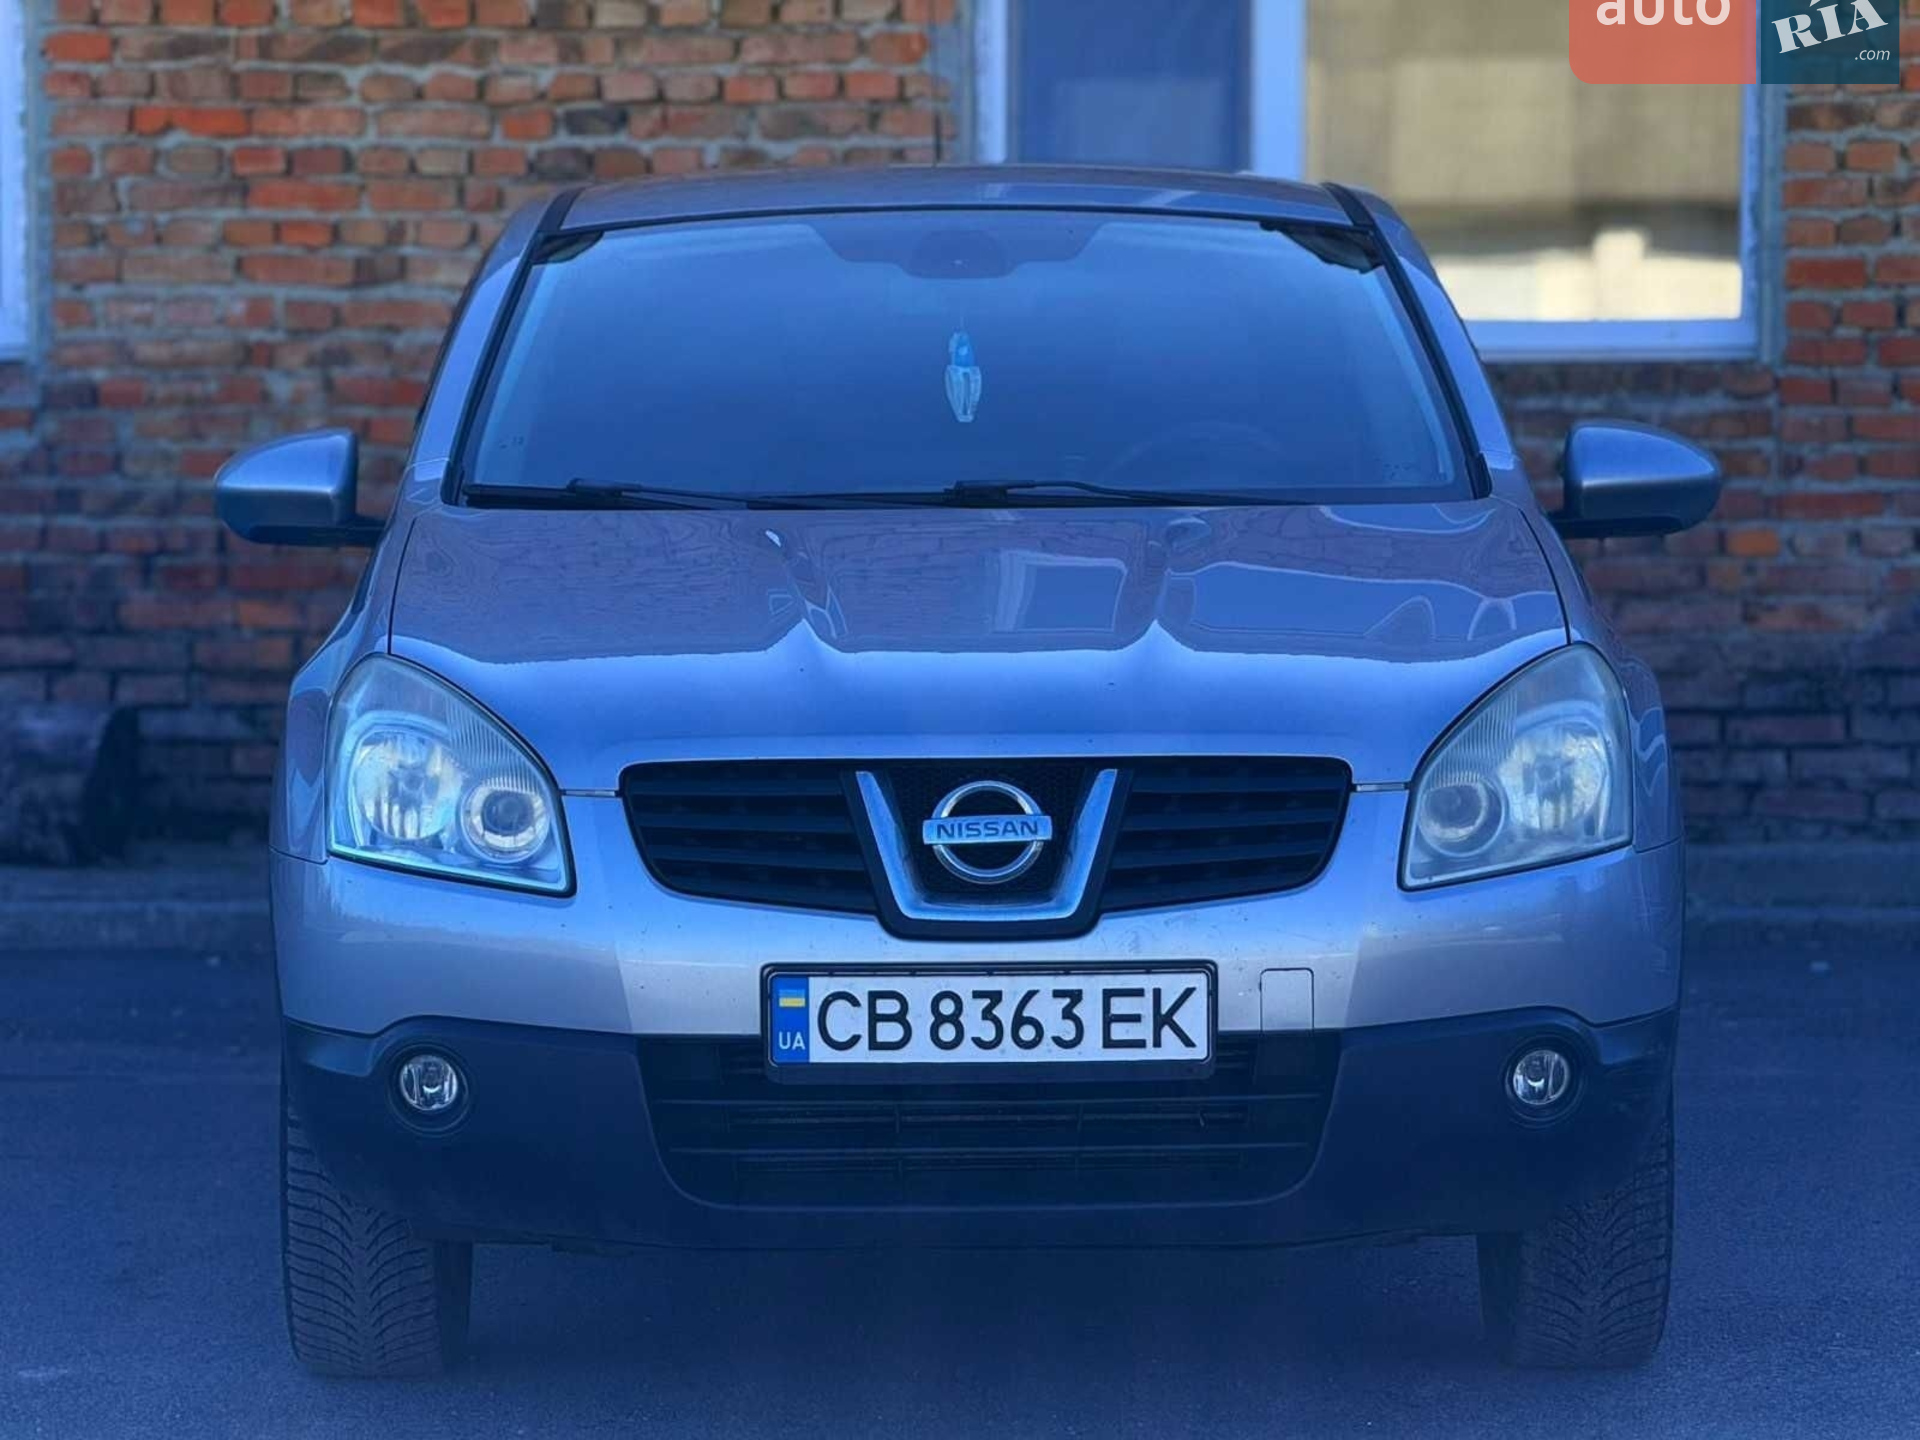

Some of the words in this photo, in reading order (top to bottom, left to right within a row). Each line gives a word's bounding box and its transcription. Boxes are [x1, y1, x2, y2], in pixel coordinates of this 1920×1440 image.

[936, 820, 1038, 839] NISSAN
[816, 989, 913, 1052] CB
[929, 988, 1085, 1051] 8363
[1101, 986, 1198, 1050] EK
[778, 1031, 806, 1051] UA
